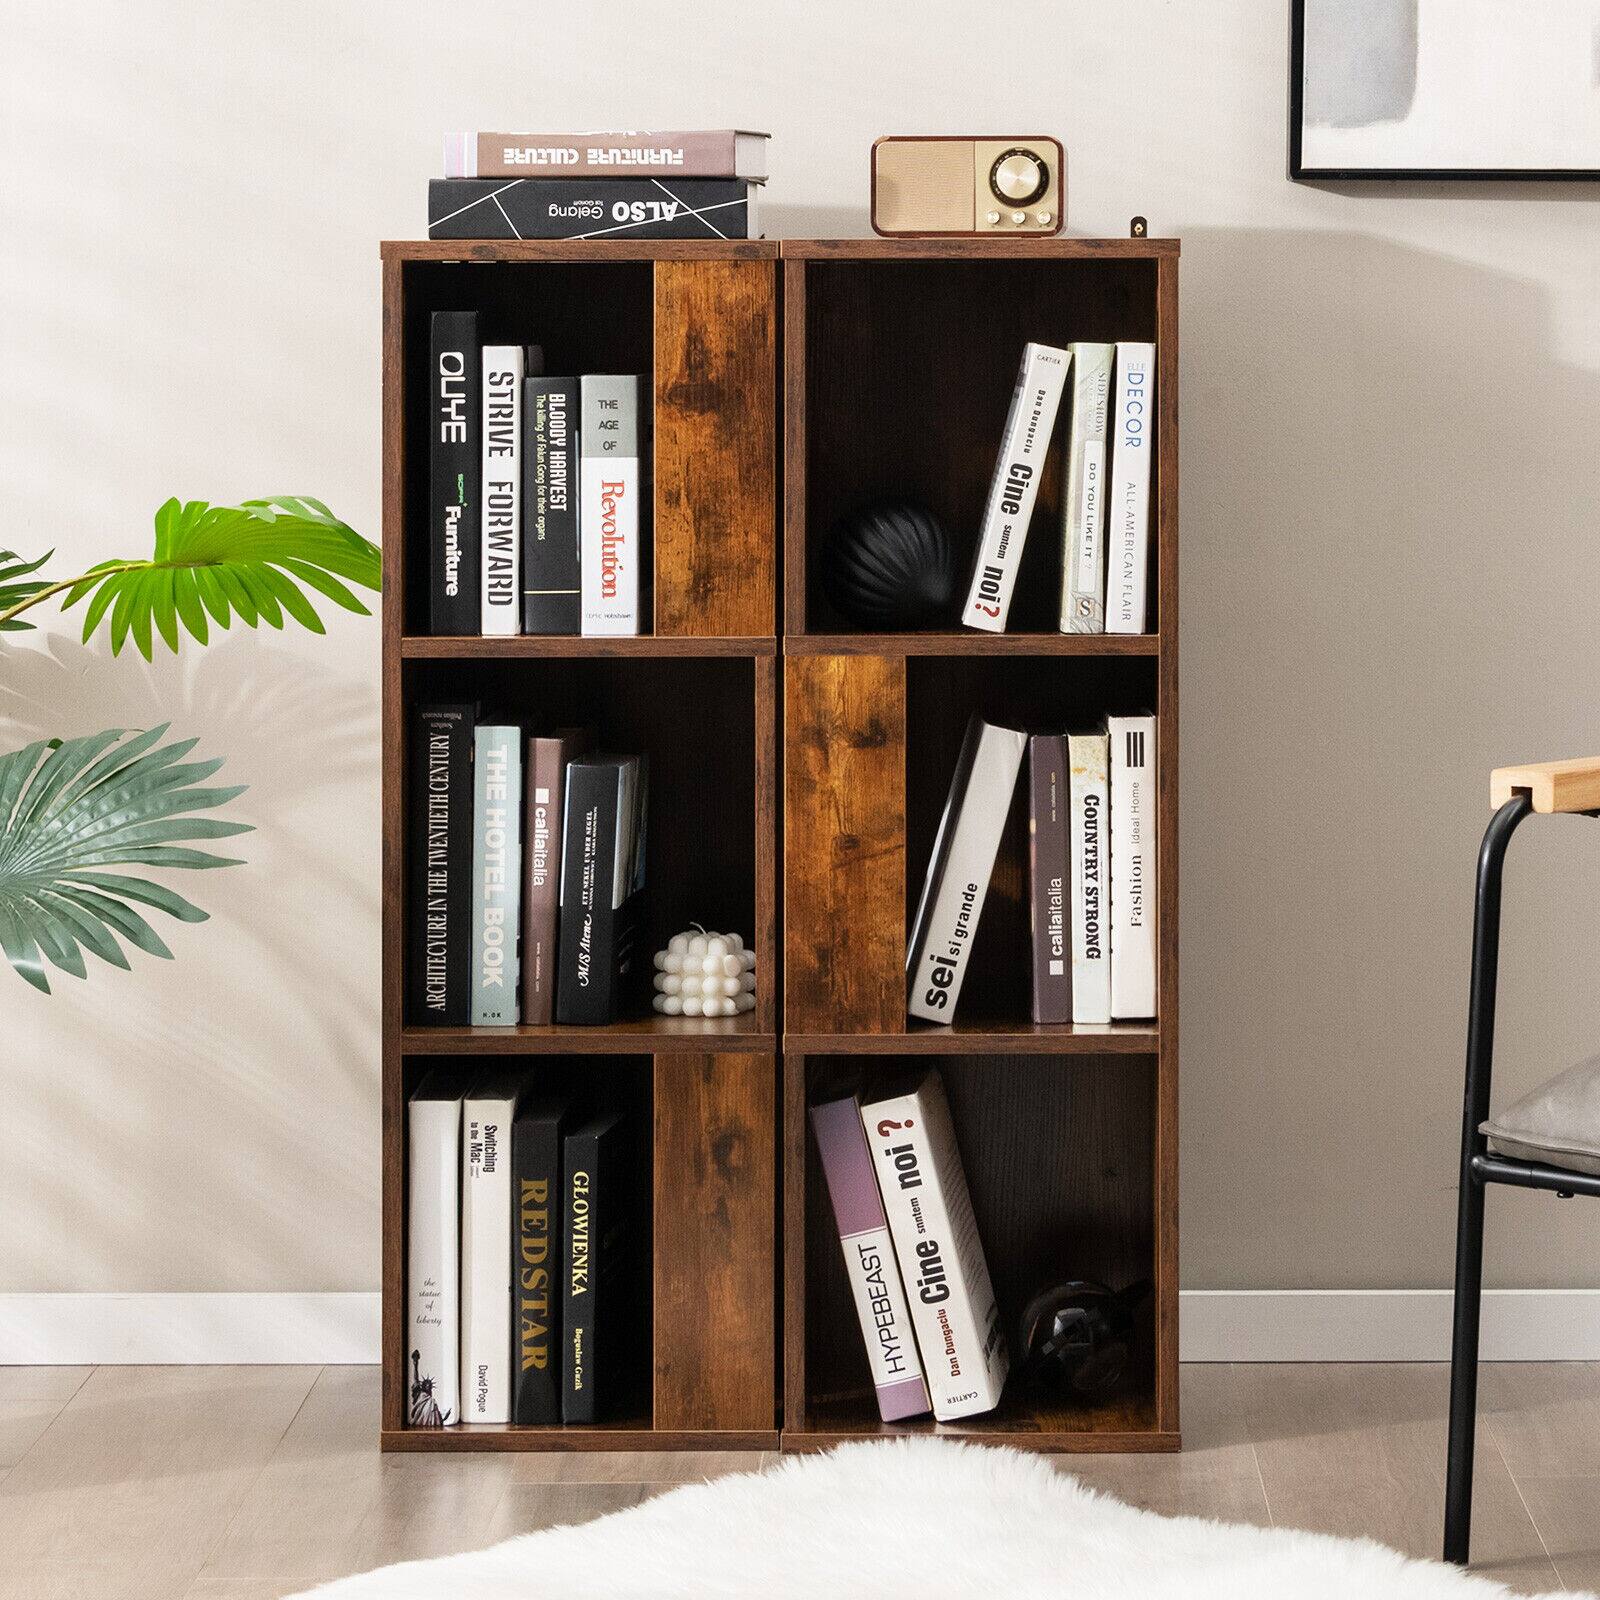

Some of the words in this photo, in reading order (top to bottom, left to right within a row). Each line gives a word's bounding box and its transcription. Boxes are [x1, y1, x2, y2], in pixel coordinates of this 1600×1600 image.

[503, 148, 579, 164] CULTURE
[587, 148, 684, 164] FURNITURE
[548, 204, 604, 219] Gelang
[612, 200, 678, 222] ALSO
[1036, 353, 1062, 365] CARTIER
[537, 394, 546, 409] The
[598, 400, 618, 410] THE
[1035, 389, 1046, 408] Dan
[1094, 371, 1107, 435] SIDESHOW
[1125, 372, 1145, 448] DECOR
[487, 371, 514, 458] STRIVE
[535, 409, 546, 431] killing
[549, 393, 567, 446] BLOODY
[598, 420, 619, 430] AGE
[537, 434, 546, 443] of
[1024, 410, 1041, 454] Dungaciu
[537, 443, 546, 463] Falun
[603, 441, 617, 451] OF
[535, 464, 546, 483] Gong
[549, 451, 567, 511] HARVEST
[1088, 463, 1097, 481] DO
[537, 485, 546, 497] for
[1000, 463, 1033, 516] Cine
[1087, 485, 1096, 511] YOU
[537, 497, 546, 514] their
[535, 516, 546, 540] organs
[601, 480, 625, 600] Revolution
[1085, 515, 1094, 542] LIKE
[1120, 482, 1135, 580] ALL-AMERICAN
[445, 505, 462, 597] Furniture
[487, 481, 514, 607] FORWARD
[997, 524, 1013, 559] suntem
[1121, 585, 1133, 621] FLAIR
[429, 733, 450, 791] CENTURY
[486, 744, 508, 801] THE
[1131, 782, 1140, 813] Home
[428, 794, 449, 867] TWENTIETH
[1083, 793, 1101, 885] COUNTRY
[1130, 816, 1140, 845] Ideal
[483, 809, 506, 900] HOTEL
[533, 807, 550, 887] caliaitalia
[428, 871, 448, 895] THE
[1130, 854, 1143, 928] Fashion
[428, 898, 448, 911] IN
[954, 883, 979, 939] grande
[1048, 878, 1064, 957] caliaitalia
[1084, 887, 1102, 960] STRONG
[482, 908, 505, 989] BOOK
[947, 940, 962, 956] si
[579, 953, 592, 987] M/S
[924, 953, 958, 1010] sei
[470, 1121, 479, 1129] to
[470, 1130, 479, 1140] the
[470, 1142, 484, 1163] Mac
[483, 1124, 498, 1174] Switching
[423, 1278, 437, 1288] the
[915, 1239, 951, 1305] Cine
[417, 1290, 442, 1298] statue
[425, 1300, 434, 1312] of
[416, 1314, 443, 1327] liberty
[858, 1243, 906, 1374] HYPEBEAST
[478, 1364, 488, 1387] David
[574, 1366, 584, 1391] Guzik
[949, 1355, 961, 1377] Dan
[477, 1388, 488, 1413] Pogue
[947, 1391, 979, 1405] CARTIER
